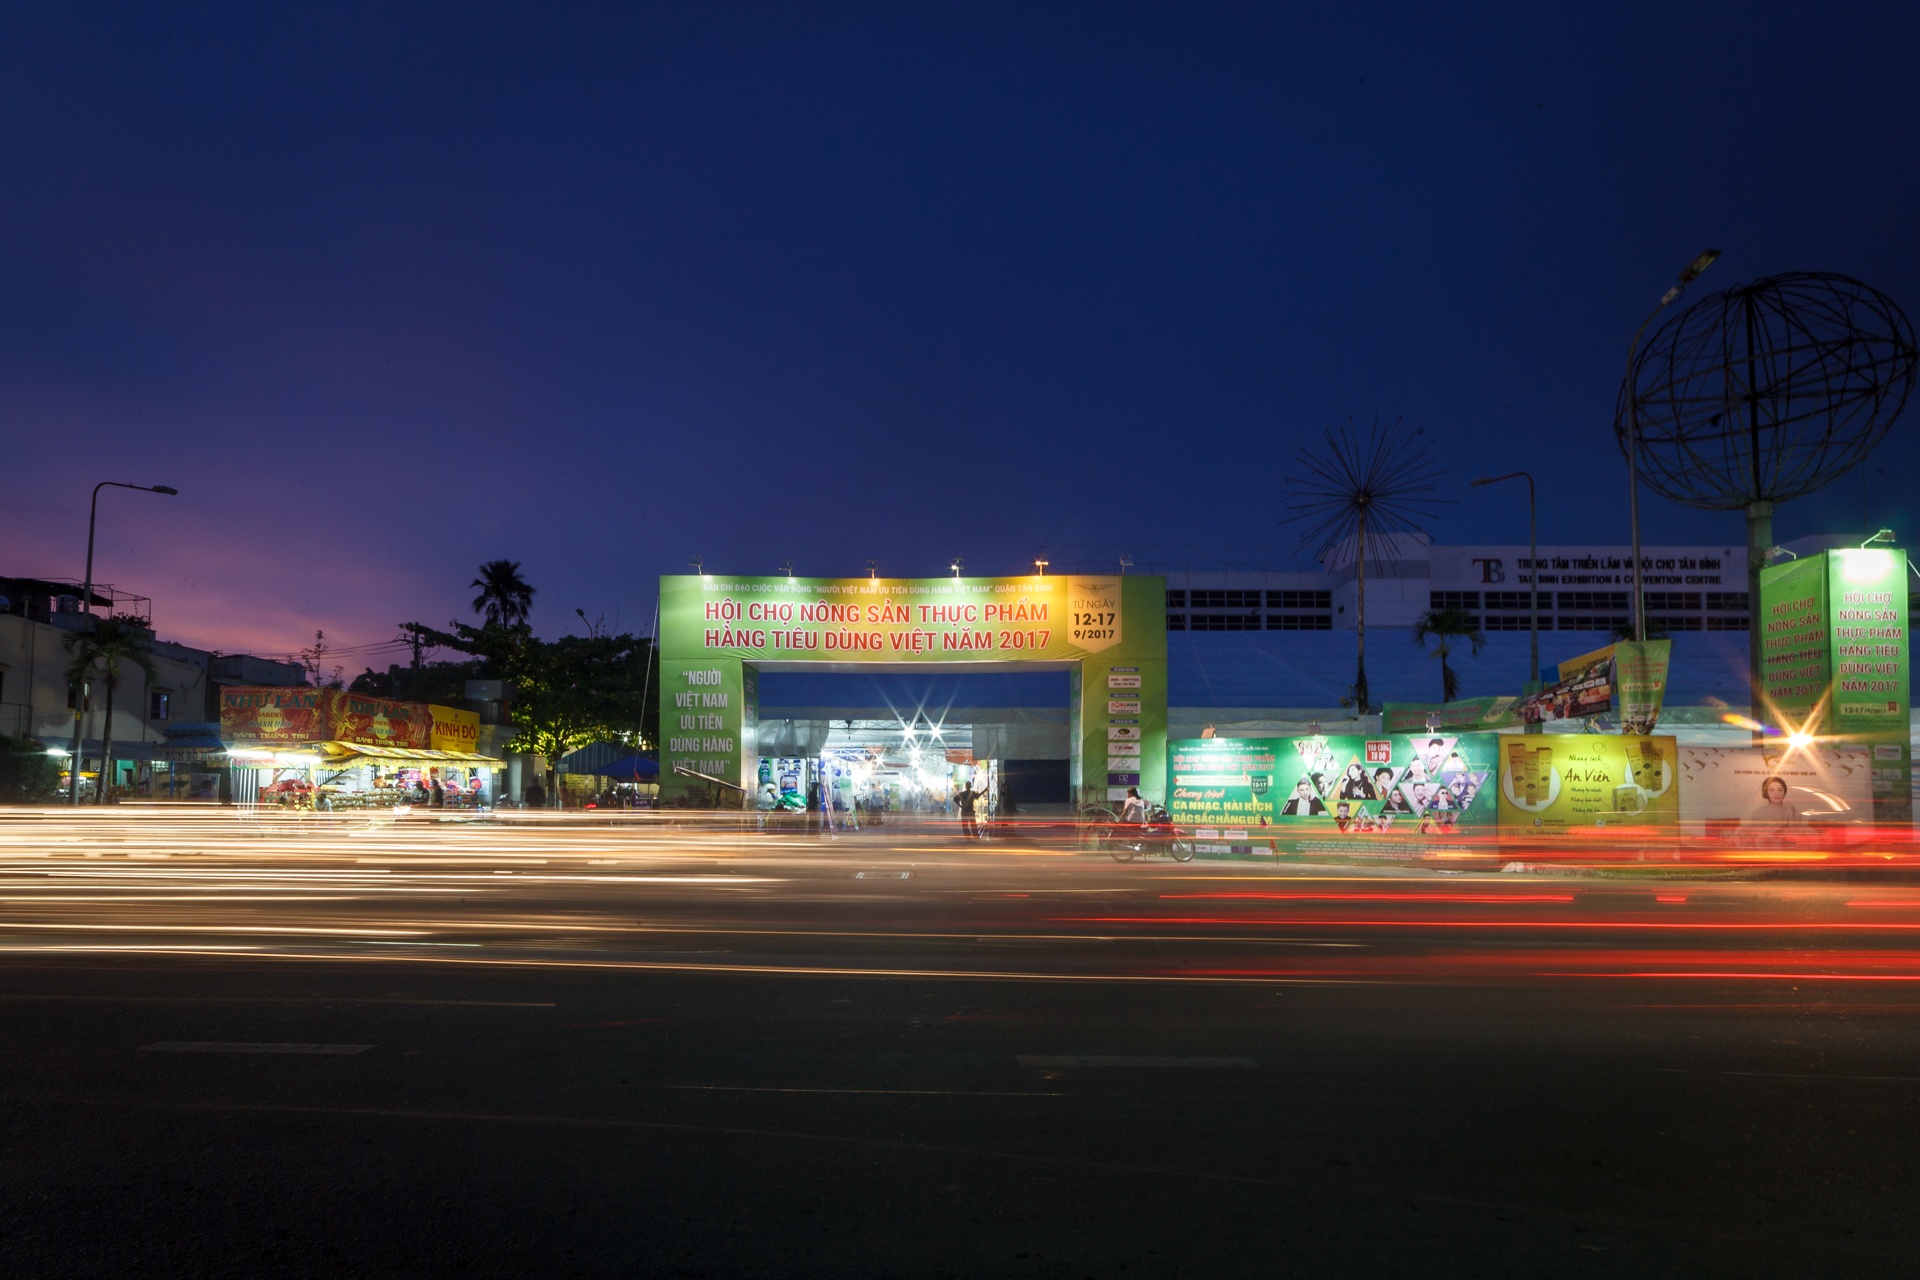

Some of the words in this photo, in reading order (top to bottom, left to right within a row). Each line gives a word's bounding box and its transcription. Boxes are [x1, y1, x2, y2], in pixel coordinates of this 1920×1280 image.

[1551, 556, 1569, 569] TÂM
[1678, 556, 1696, 569] TÂN
[1518, 575, 1534, 583] TA
[1538, 575, 1558, 583] BINH
[1561, 575, 1612, 584] EXHIBITION
[1614, 576, 1621, 584] &
[1624, 576, 1682, 584] CVENTION
[1685, 576, 1721, 584] CENTRE
[703, 583, 719, 592] BAN
[735, 583, 751, 594] ĐẠO
[752, 582, 772, 594] CUỘC
[842, 584, 858, 595] VIỆT
[860, 586, 877, 594] NAM
[891, 584, 908, 594] TIÊN
[909, 584, 930, 594] DÙNG
[932, 584, 953, 594] HÀNG
[954, 584, 971, 595] VIỆT
[995, 583, 1016, 594] QUẬN
[1017, 582, 1033, 592] TÂN
[1073, 598, 1085, 609] TỪ
[1086, 598, 1116, 609] NGÀY
[1844, 589, 1864, 605] HỘI
[1868, 592, 1892, 605] CHỢ
[705, 598, 742, 624] HỘI
[749, 601, 794, 626] CHỢ
[800, 599, 860, 623] NÔNG
[867, 599, 910, 623] SẢN
[918, 603, 978, 627] THỰC
[984, 597, 1048, 622] PHẨM
[1772, 601, 1791, 616] HỘI
[1792, 596, 1815, 613] CHỢ
[1839, 607, 1872, 621] NÔNG
[1875, 606, 1897, 621] SẢN
[1073, 613, 1116, 626] 12-17
[1768, 618, 1797, 633] NÔNG
[1799, 611, 1821, 627] SẢN
[705, 625, 766, 648] HÀNG
[771, 626, 818, 649] TIÊU
[825, 627, 883, 650] DÙNG
[890, 628, 938, 655] VIỆT
[943, 627, 992, 650] NĂM
[1000, 630, 1051, 649] 2017
[1073, 629, 1115, 640] 9/2017
[1765, 634, 1792, 651] THỰC
[1794, 627, 1825, 645] PHẨM
[1836, 628, 1867, 641] THỰC
[1869, 625, 1902, 639] PHẨM
[1768, 650, 1796, 665] HÀNG
[1799, 646, 1822, 661] TIÊU
[1839, 642, 1872, 656] HÀNG
[1875, 643, 1899, 656] TIÊU
[1769, 668, 1796, 683] DÙNG
[1799, 663, 1821, 679] VIỆT
[1840, 660, 1872, 675] DÙNG
[1875, 660, 1899, 676] VIỆT
[1770, 684, 1792, 698] NĂM
[1796, 683, 1821, 696] 2017
[1841, 678, 1867, 692] NĂM
[1871, 680, 1898, 692] 2017
[223, 692, 270, 708] NHƯ
[273, 694, 318, 708] LAN
[675, 690, 700, 710] VIỆT
[702, 693, 728, 707] NAM
[349, 700, 380, 716] NHƯ
[383, 704, 409, 720] LAN
[680, 714, 695, 729] ƯU
[698, 712, 723, 729] TIÊN
[435, 721, 460, 738] KINH
[462, 723, 476, 739] ĐÔ
[670, 735, 700, 752] DÙNG
[702, 735, 733, 752] HÀNG
[1569, 754, 1588, 763] Nhang
[1564, 767, 1581, 783] An
[1584, 768, 1610, 783] Viên
[1173, 801, 1188, 810] CA
[1223, 799, 1243, 811] HÀI
[1244, 801, 1273, 813] KỊCH
